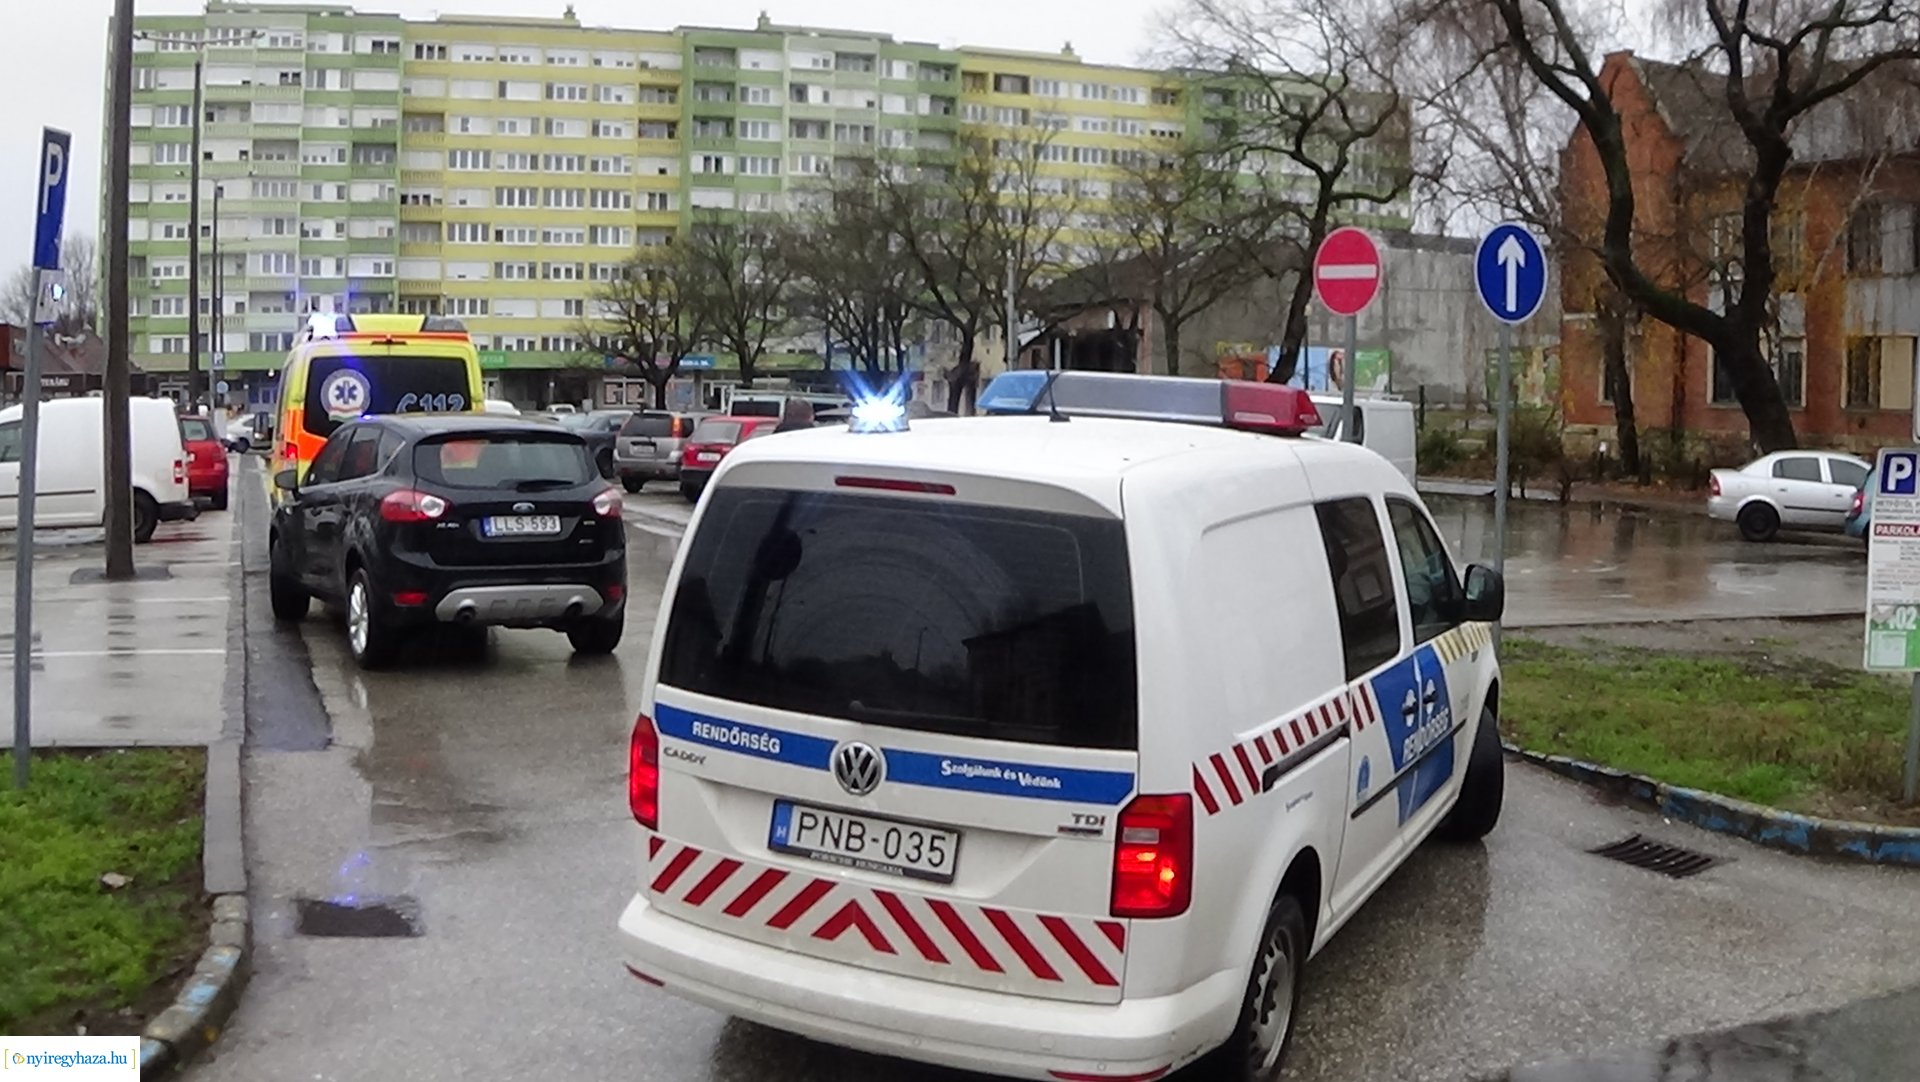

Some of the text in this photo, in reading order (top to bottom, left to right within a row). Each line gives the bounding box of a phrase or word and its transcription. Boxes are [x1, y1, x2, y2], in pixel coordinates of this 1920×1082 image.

[42, 142, 63, 215] P
[1887, 456, 1912, 491] P
[692, 721, 781, 754] RENDŐRSÉG
[663, 746, 706, 765] CADDY
[941, 760, 1061, 789] Szolgálunk és Védünk
[1072, 813, 1105, 827] TDI
[796, 811, 947, 868] PNB-035
